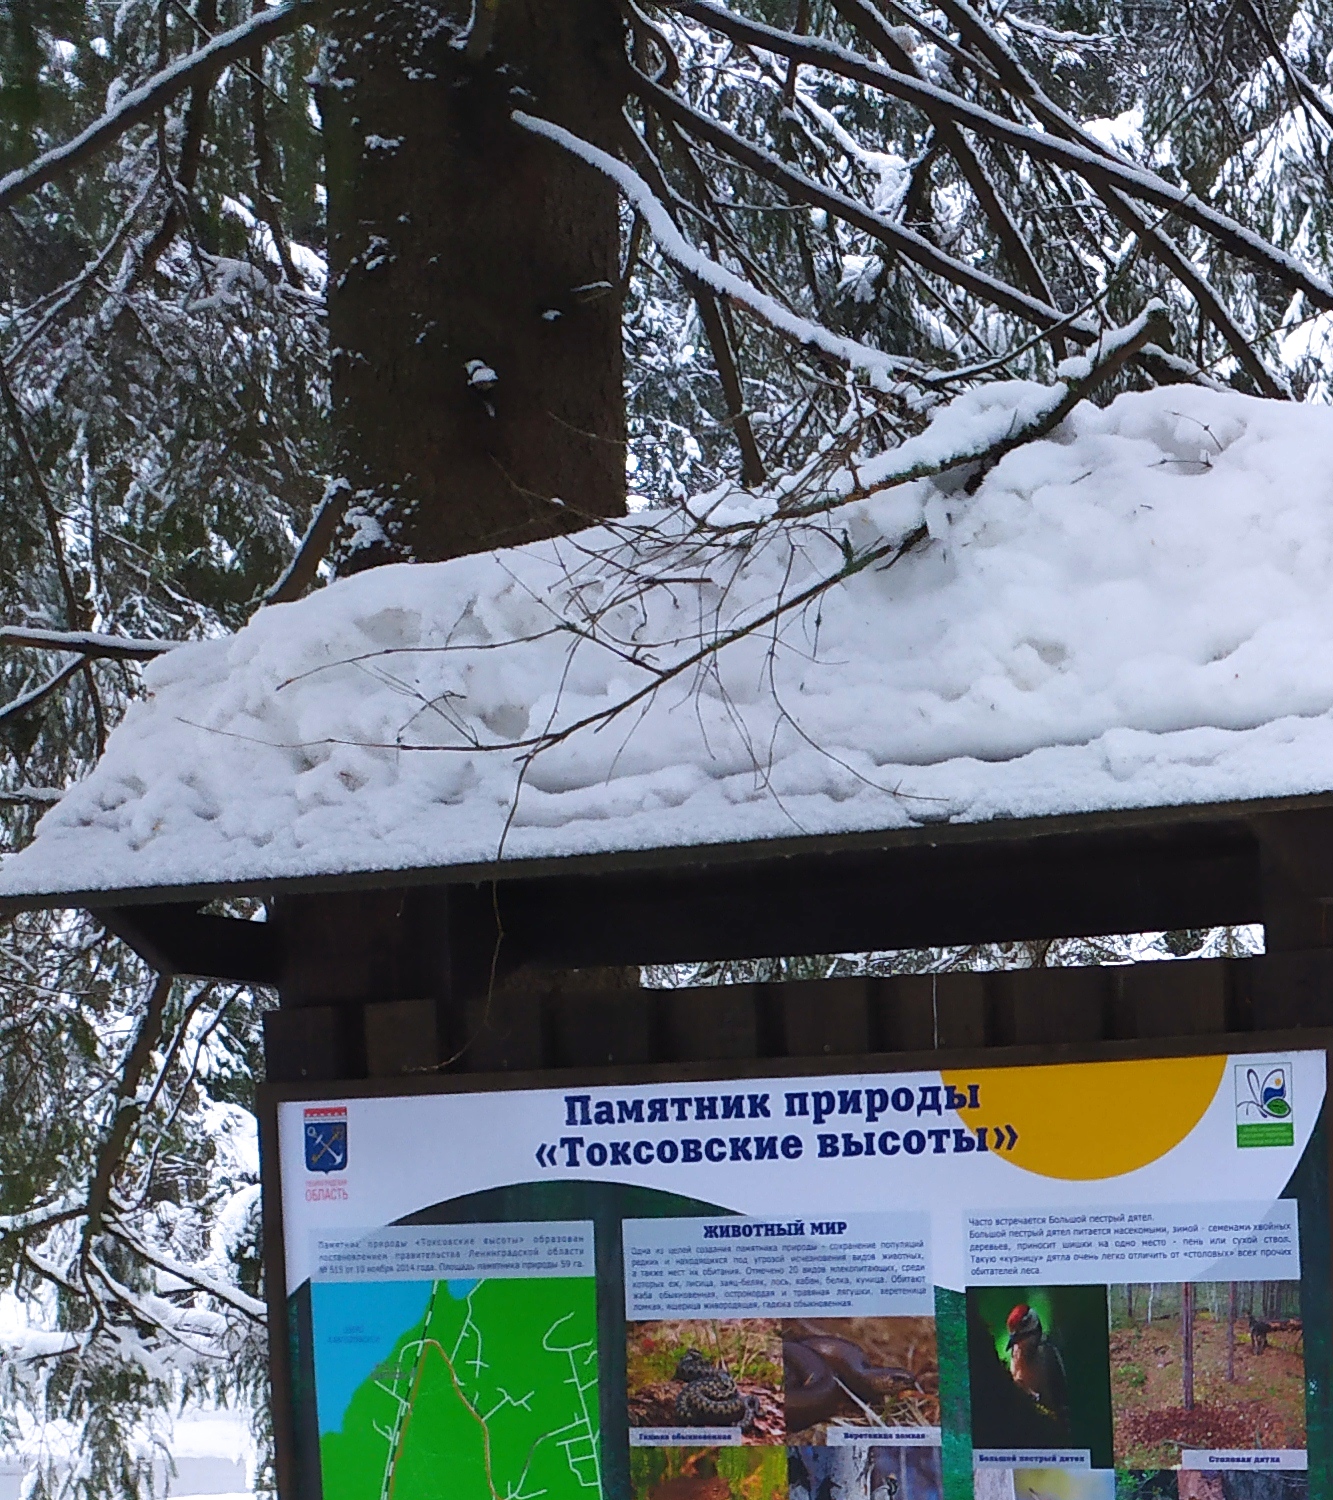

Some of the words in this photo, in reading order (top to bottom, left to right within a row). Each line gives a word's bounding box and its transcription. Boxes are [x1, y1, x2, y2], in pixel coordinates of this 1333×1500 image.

[563, 1092, 771, 1126] Памятник
[783, 1084, 980, 1122] природы
[535, 1133, 803, 1168] «Токсовские
[816, 1126, 1018, 1158] высоты»
[305, 1189, 348, 1201] ОБЛАСТЬ
[703, 1219, 805, 1238] ЖИВОТНЫЙ
[809, 1221, 847, 1235] МИР
